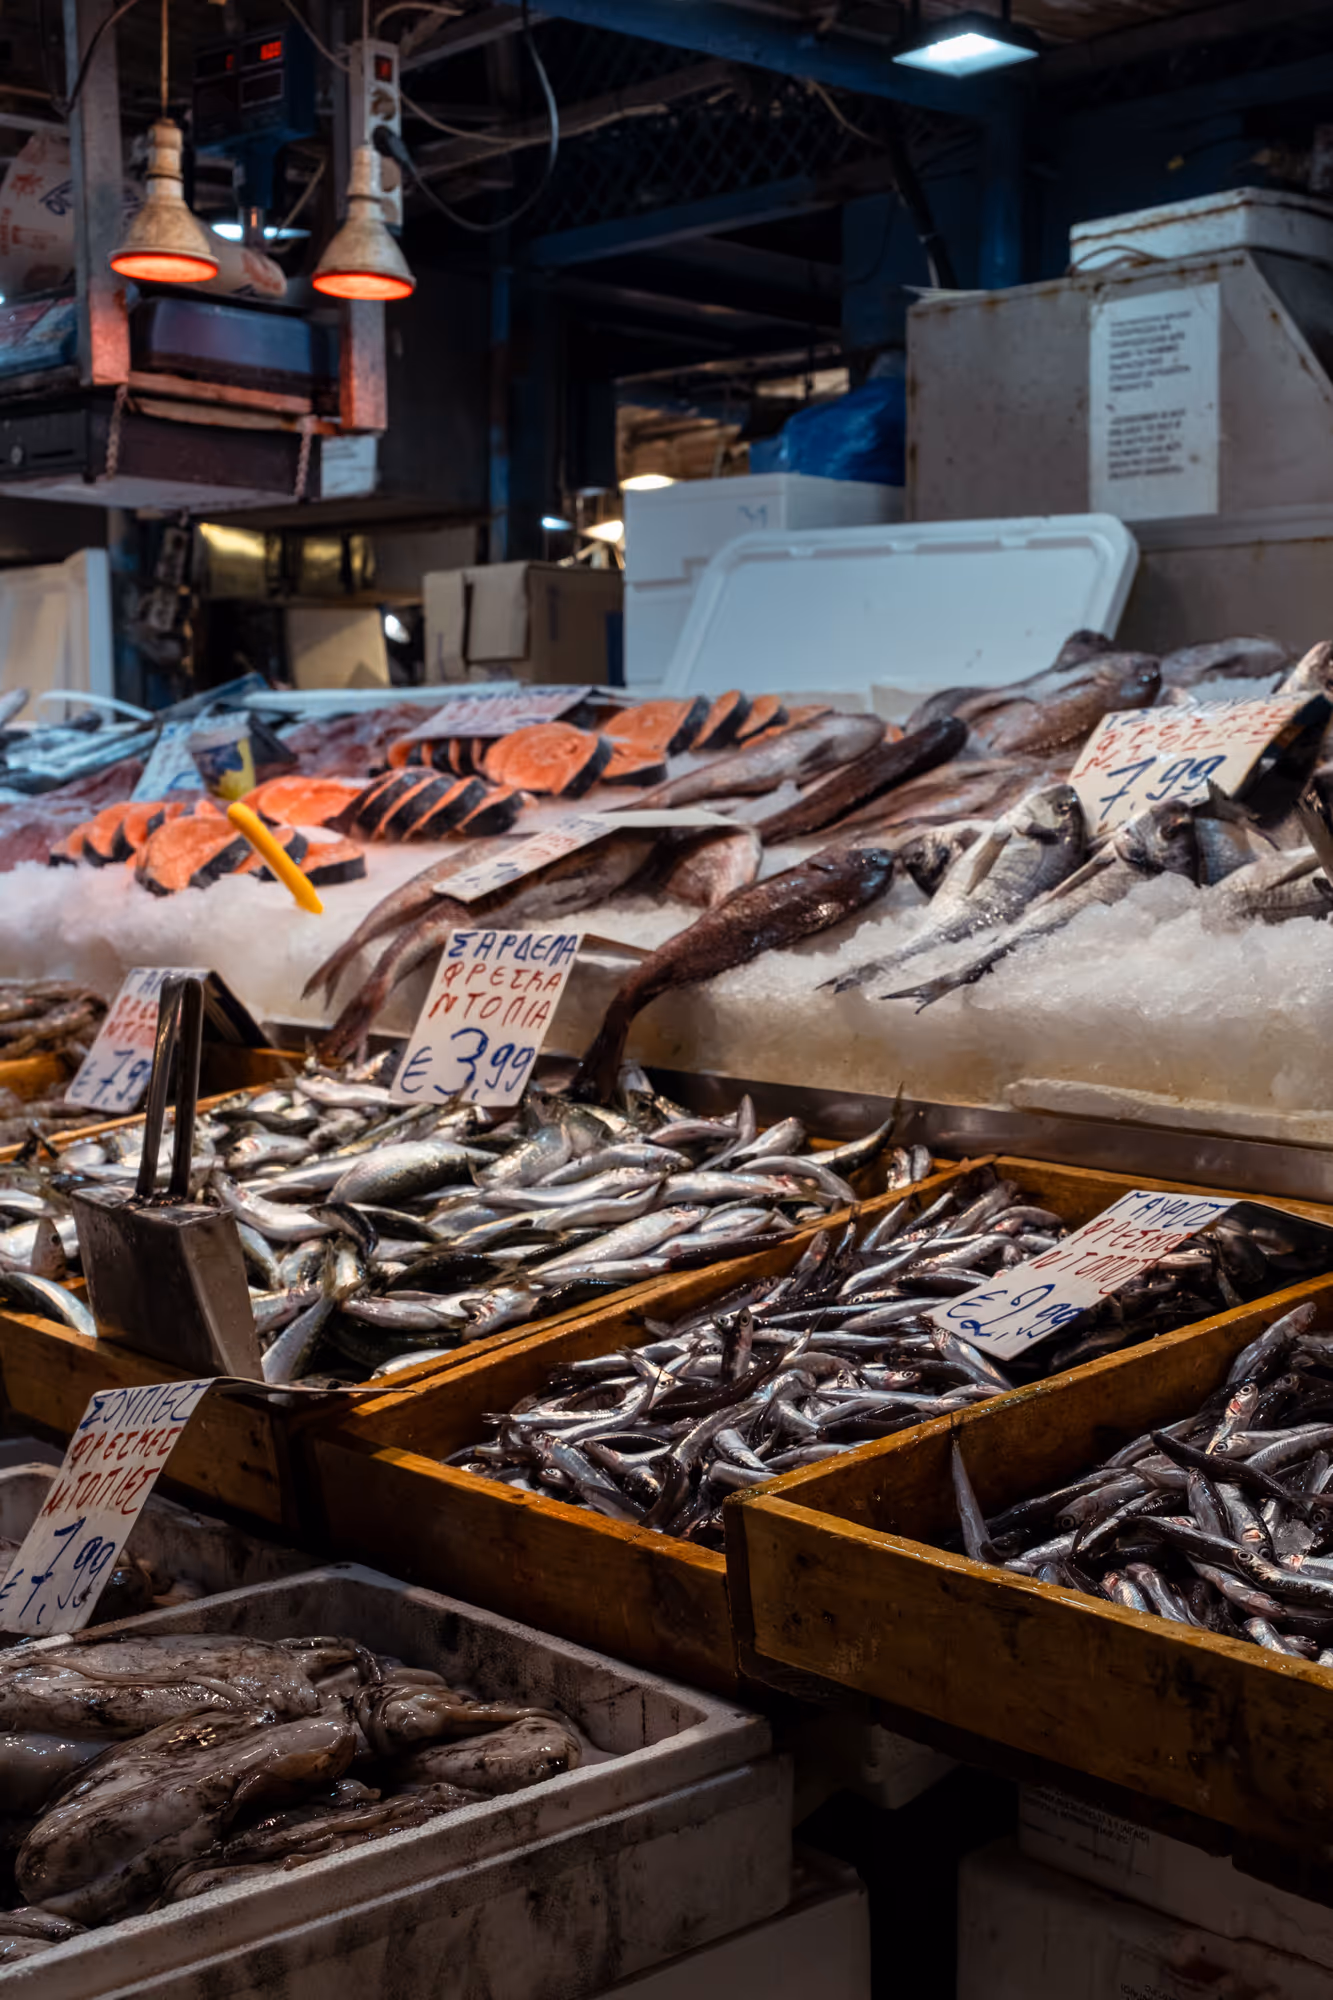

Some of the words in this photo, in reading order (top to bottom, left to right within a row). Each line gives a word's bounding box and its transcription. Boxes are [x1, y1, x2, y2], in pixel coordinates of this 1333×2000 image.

[441, 961, 563, 993] ΦΡΕΣΚΑ
[428, 992, 551, 1029] ΝΤΟΠΙΑ
[1107, 1192, 1231, 1228] ΓΑΥΡΟΣ
[79, 1383, 211, 1430] ΣΟΥΠΙΕΣ
[69, 1426, 184, 1473] ΦΡΕΣΚΕΣ
[41, 1464, 161, 1516] ΝΤΟΠΙΕΣ
